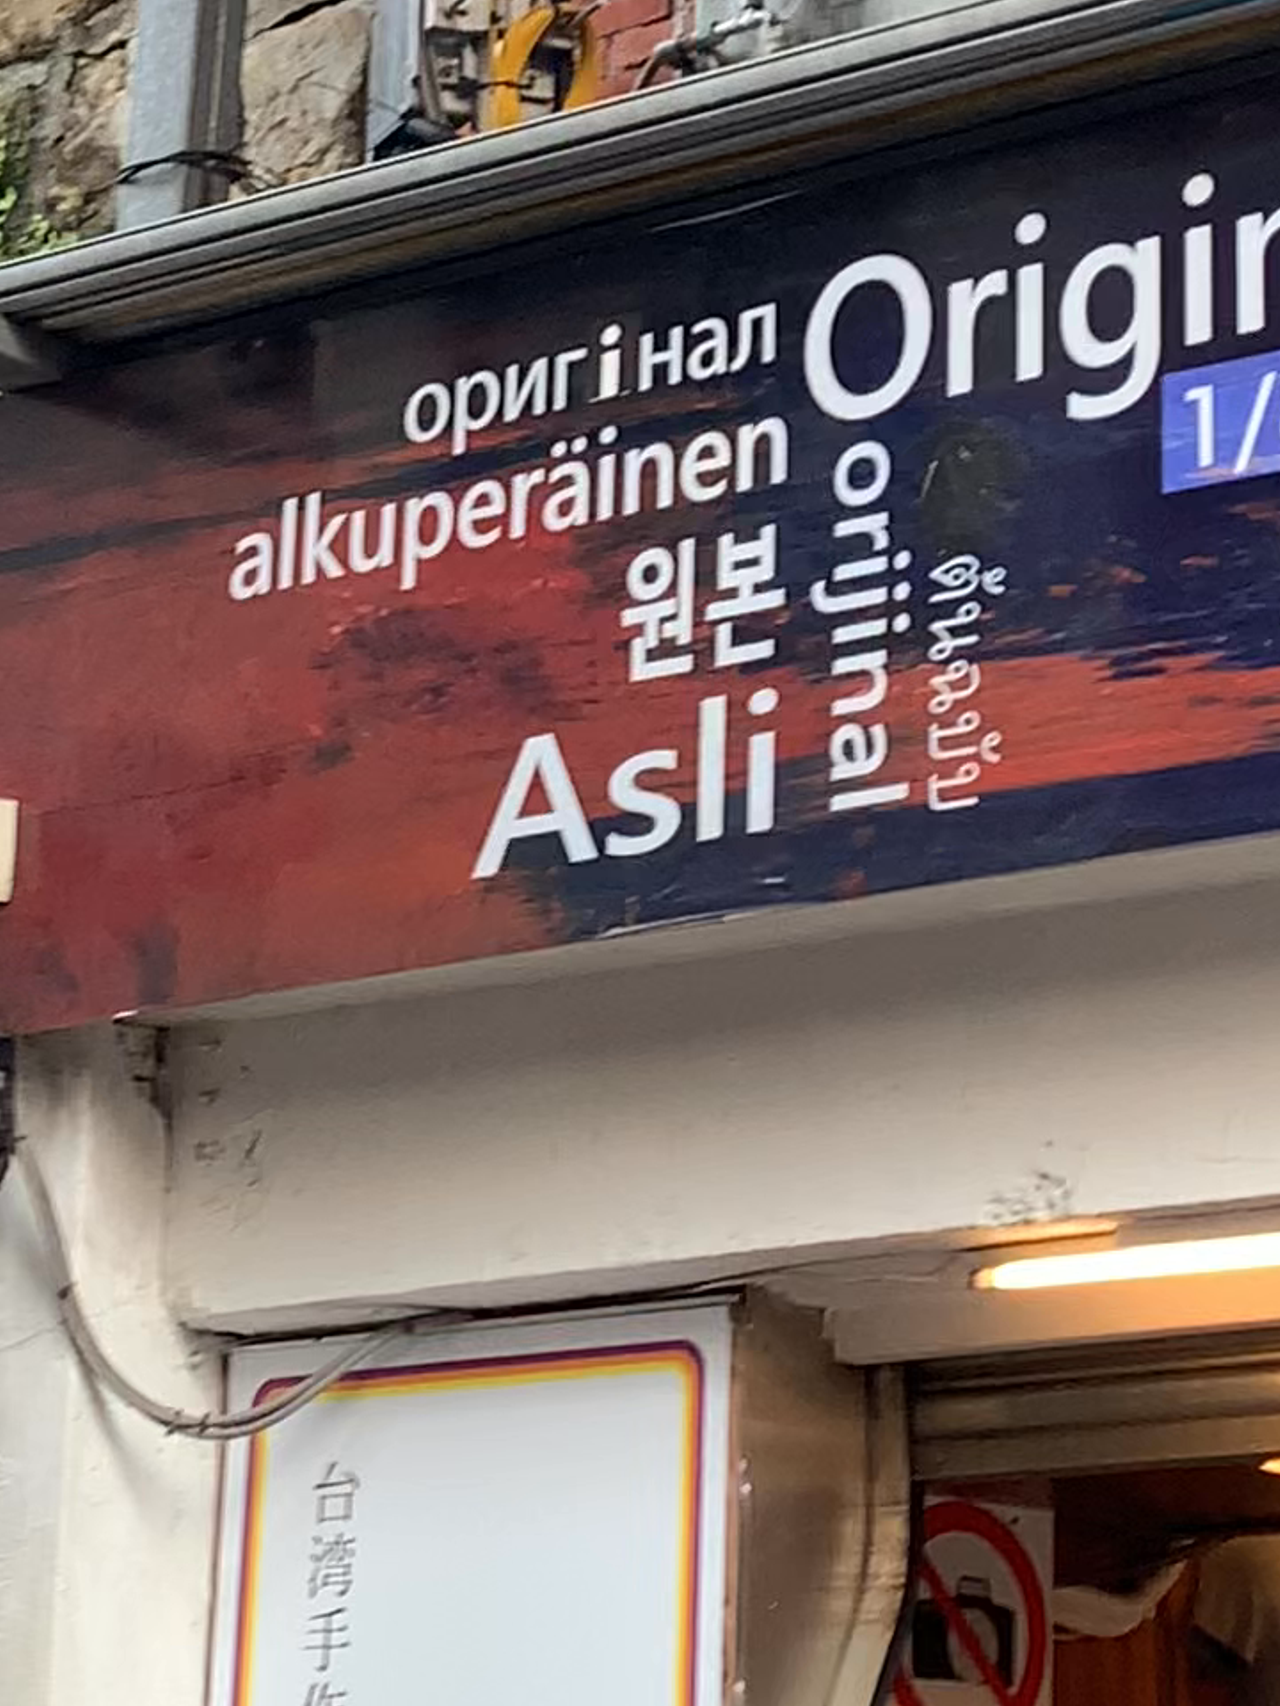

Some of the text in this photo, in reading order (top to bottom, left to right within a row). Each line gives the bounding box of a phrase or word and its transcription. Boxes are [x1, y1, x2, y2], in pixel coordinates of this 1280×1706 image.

[402, 301, 779, 457] оригінал
[228, 415, 789, 602] alkuperäinen
[620, 523, 786, 683] 원본
[810, 439, 912, 813] orijinal
[927, 553, 1008, 812] ต้นฉบับ
[470, 687, 780, 881] Asli
